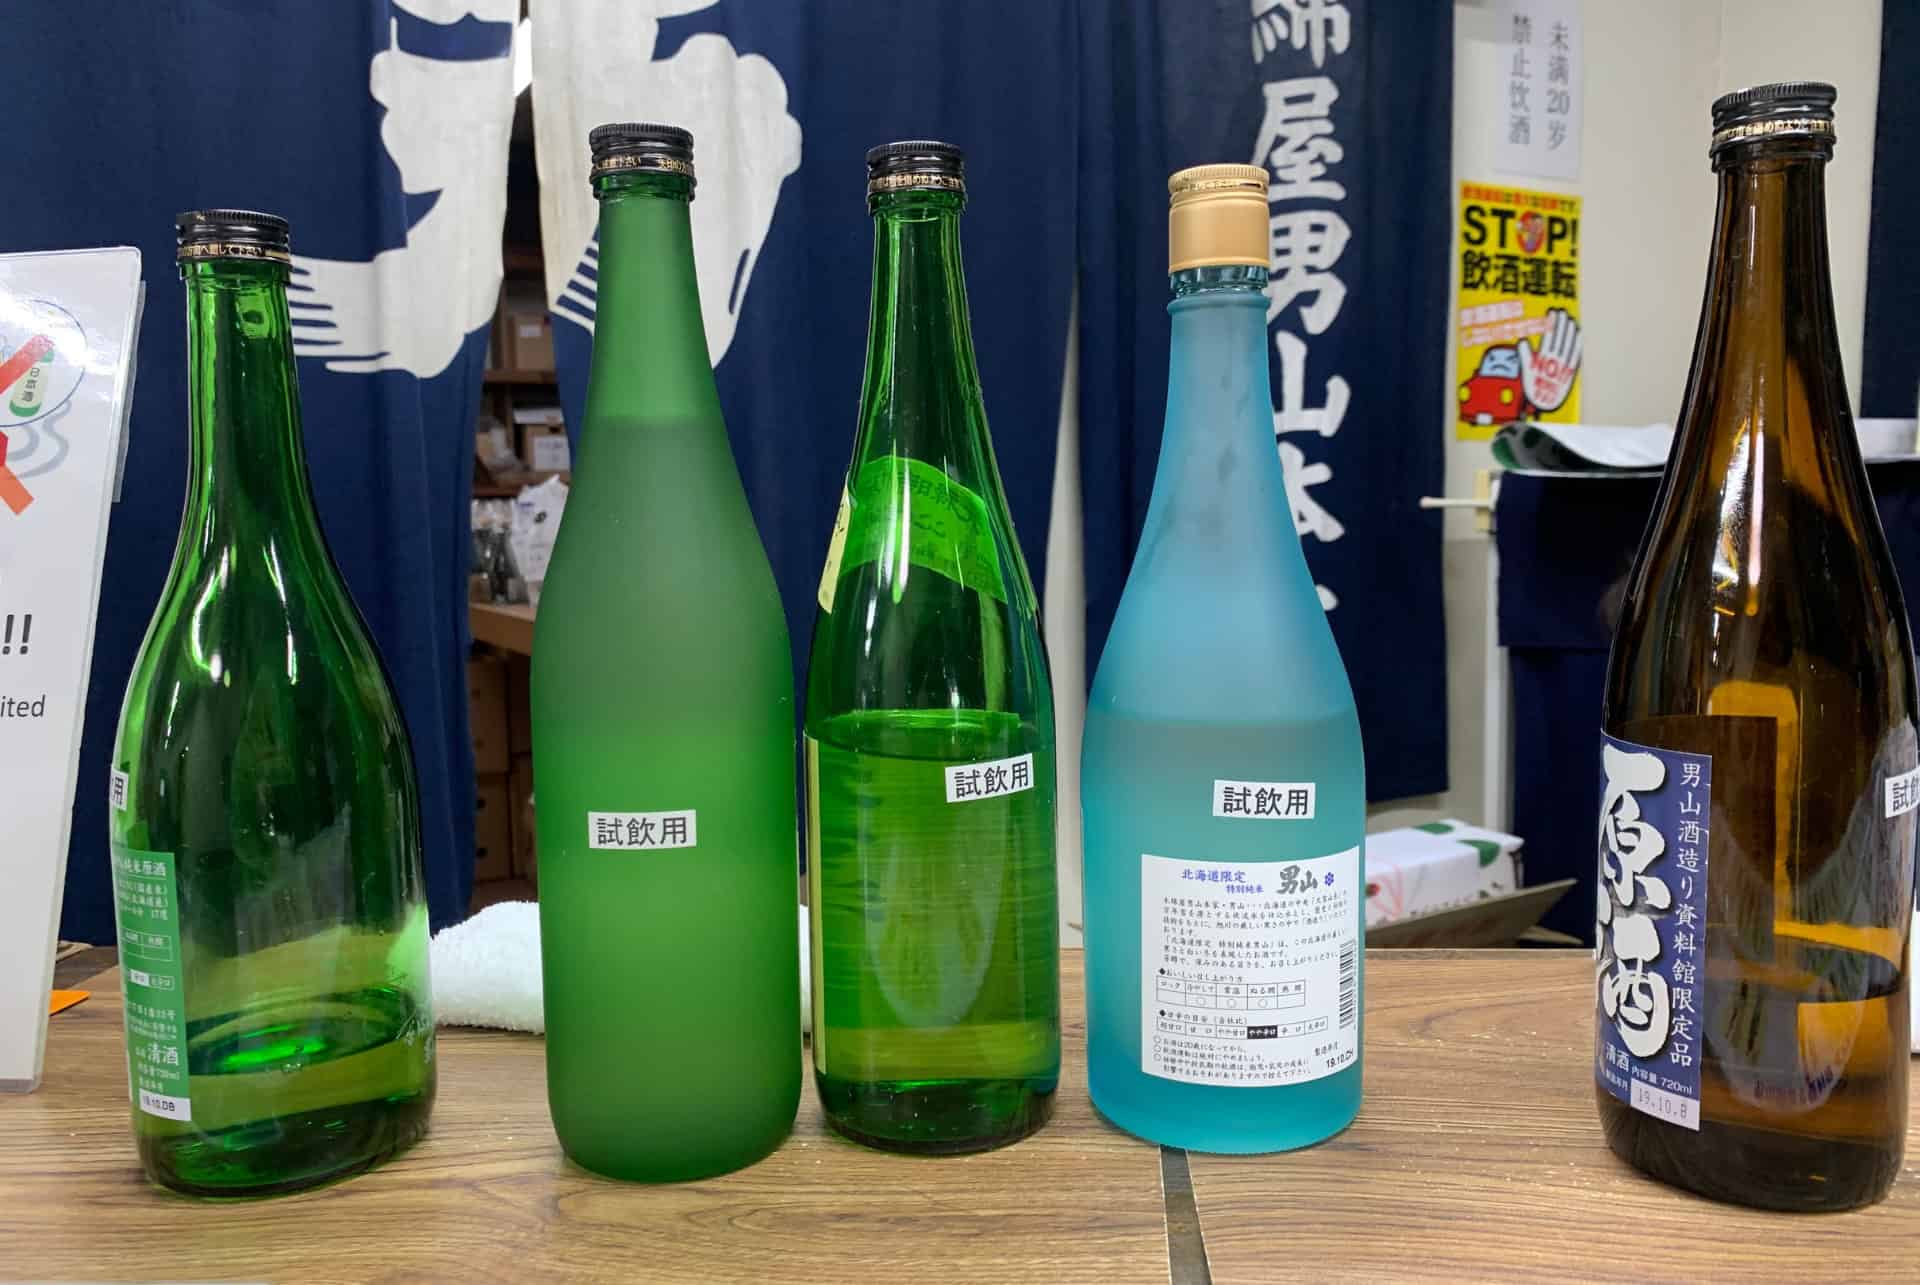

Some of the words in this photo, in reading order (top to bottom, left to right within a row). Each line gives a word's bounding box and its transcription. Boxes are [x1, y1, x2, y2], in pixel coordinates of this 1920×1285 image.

[1462, 249, 1577, 299] 飲酒運転
[954, 761, 1029, 798] 試飲用
[1223, 786, 1309, 816] 試飲用
[596, 817, 687, 845] 試飲用
[1181, 869, 1246, 884] 北海道限定
[1276, 865, 1318, 895] 男山
[1607, 1041, 1630, 1072] 清酒
[1661, 1077, 1692, 1095] 720ml
[1637, 1085, 1688, 1120] 19.10.8
